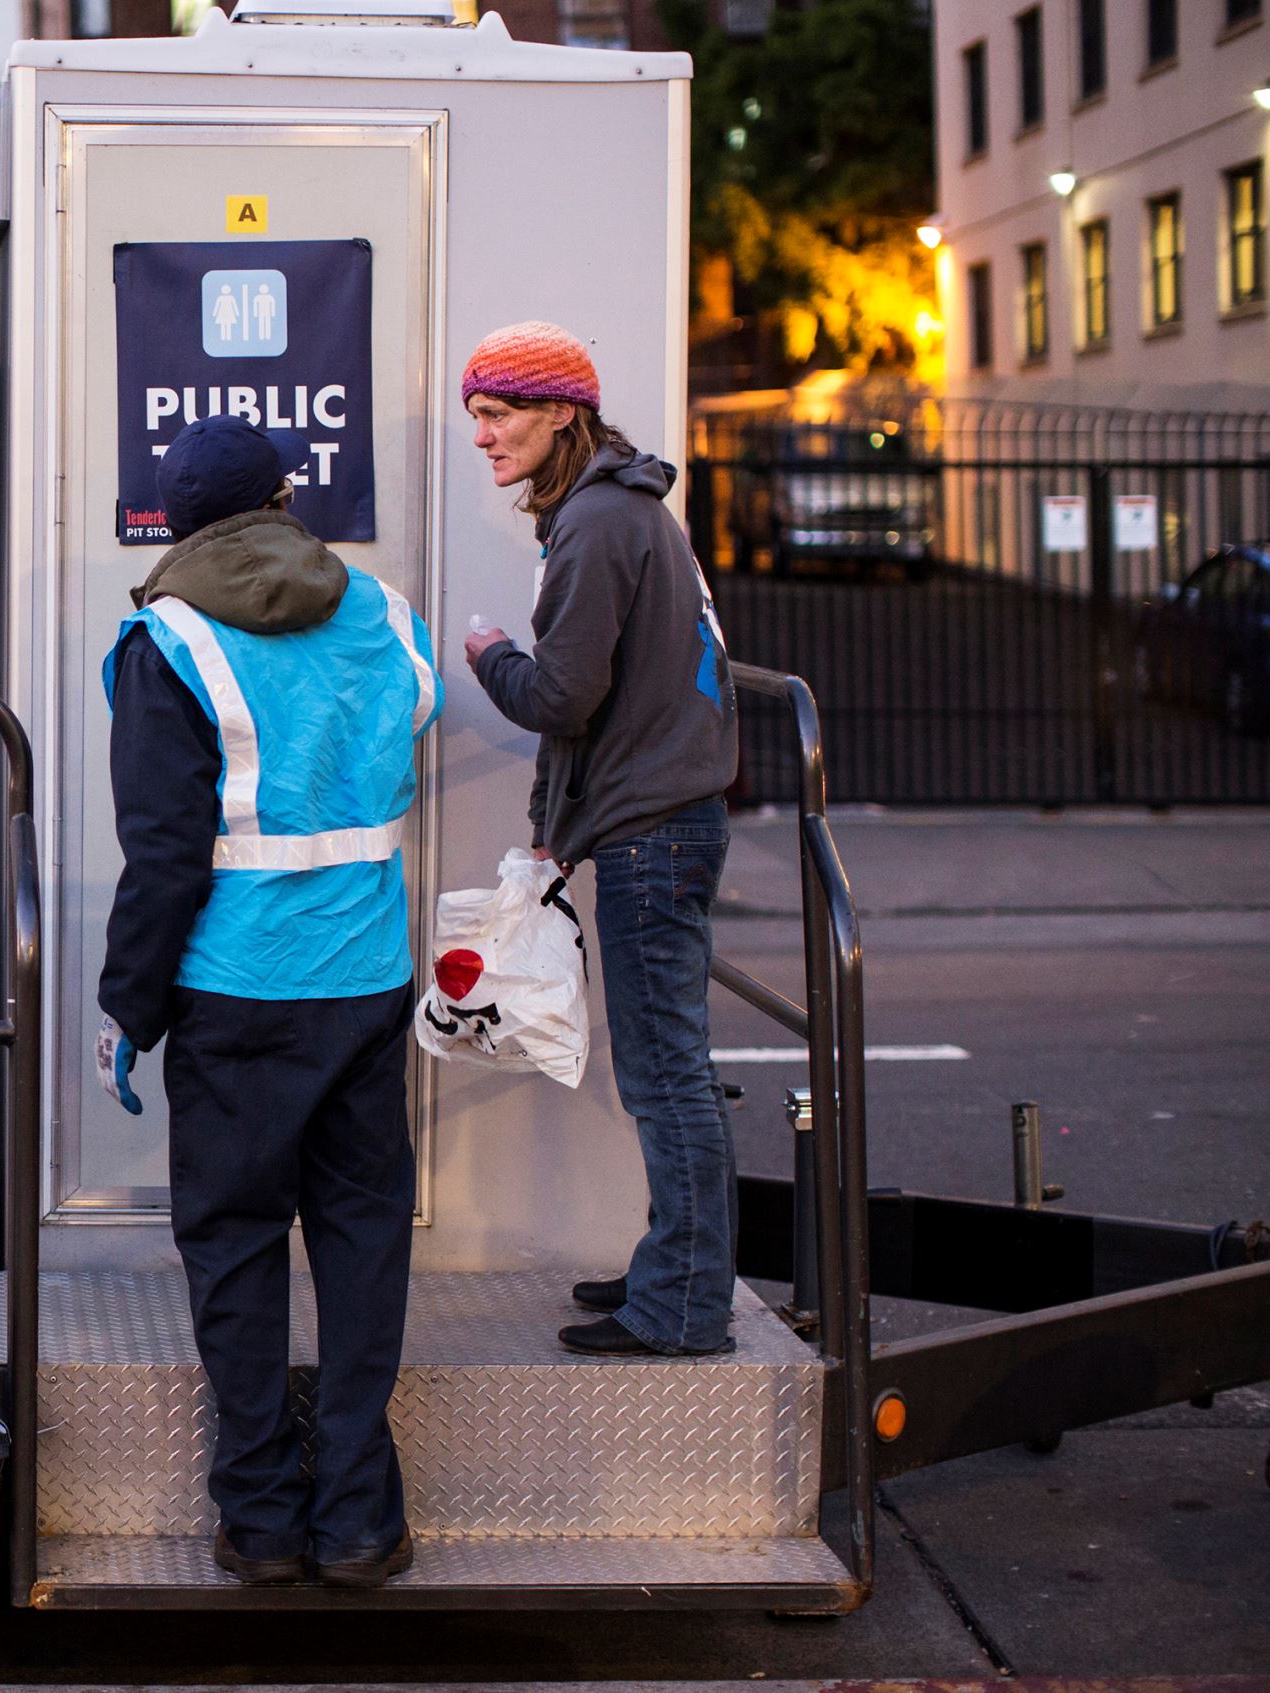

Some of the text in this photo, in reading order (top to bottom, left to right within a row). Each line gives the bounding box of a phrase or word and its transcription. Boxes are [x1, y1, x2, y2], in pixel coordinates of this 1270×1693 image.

[238, 203, 257, 222] A
[146, 384, 346, 430] PUBLIC
[125, 509, 167, 525] Tenderlo
[126, 528, 143, 537] PIT
